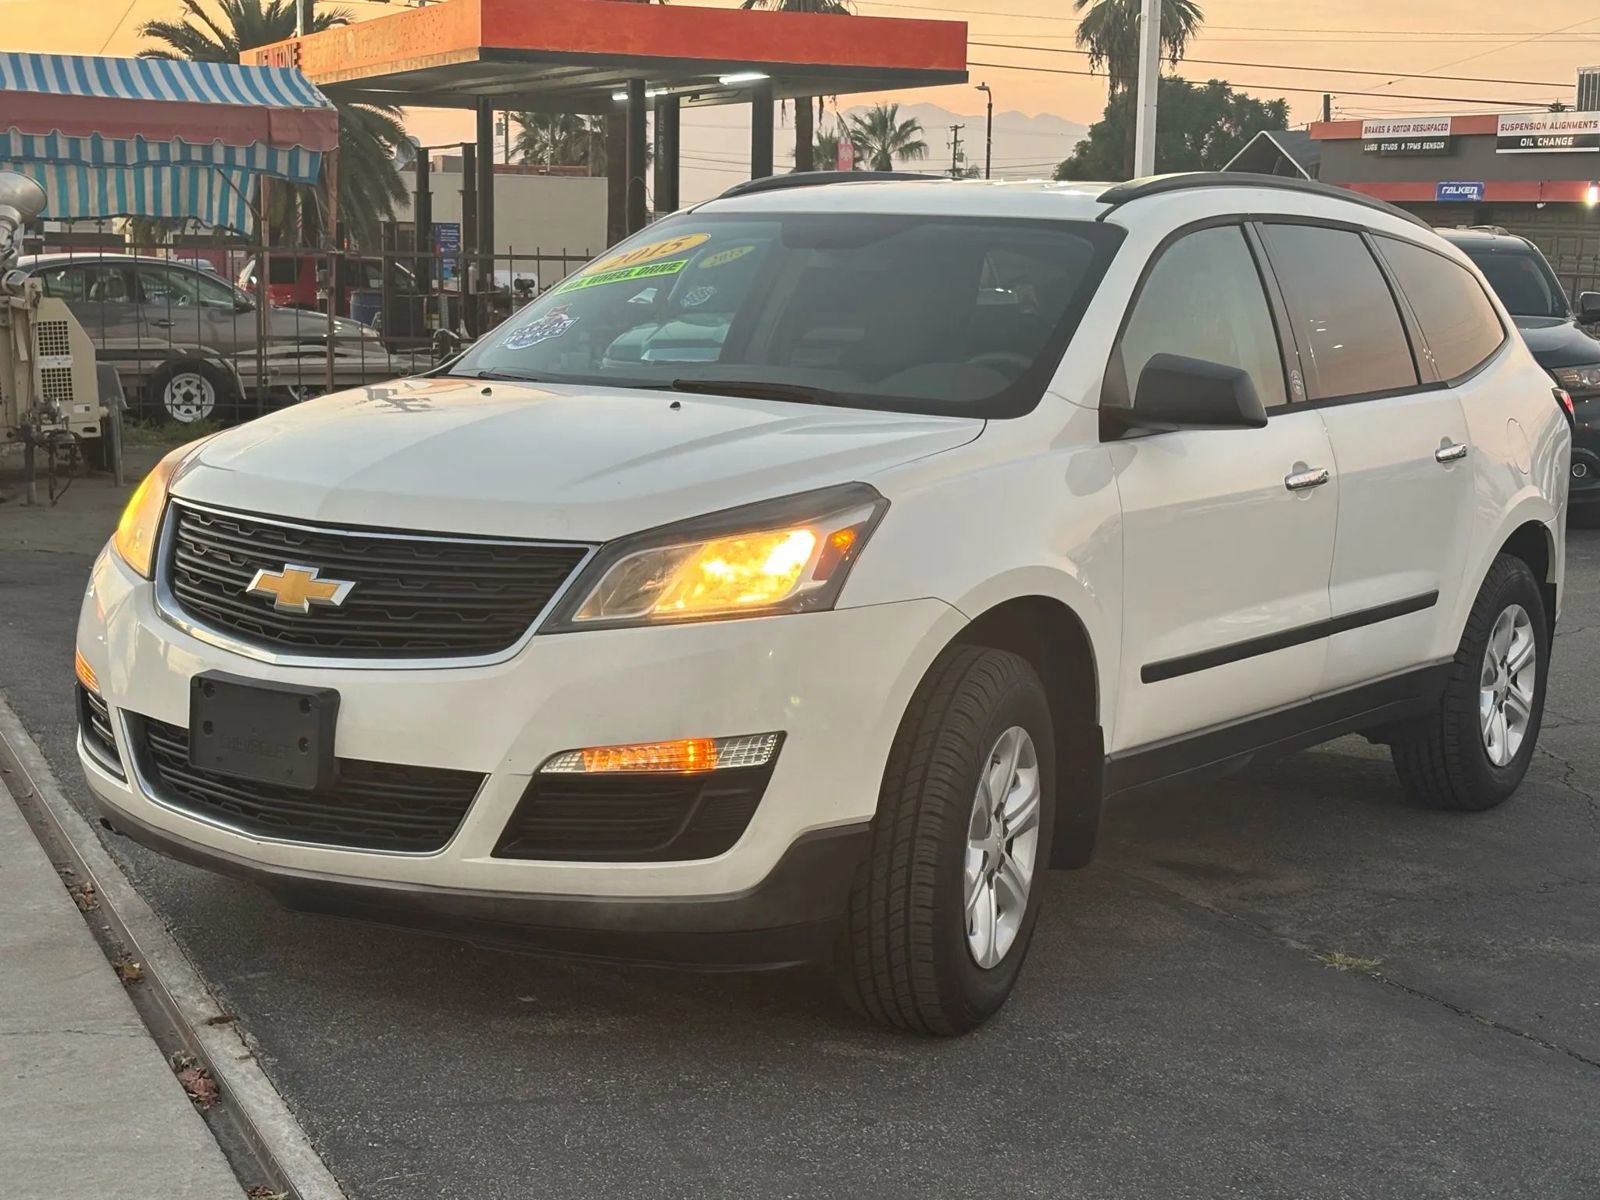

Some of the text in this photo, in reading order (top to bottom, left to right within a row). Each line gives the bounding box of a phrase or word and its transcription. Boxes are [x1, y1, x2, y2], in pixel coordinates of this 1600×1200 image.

[1364, 125, 1385, 134] BRAKES
[1392, 124, 1411, 133] ROTOR
[1412, 123, 1449, 133] RESURFACED
[1500, 120, 1599, 131] SUSPENSION ALIGNMENTS
[1380, 143, 1398, 151] STUDS
[1422, 141, 1445, 150] SENSOR
[1520, 136, 1574, 147] OIL CHANGE
[1441, 186, 1478, 195] FALKEN
[601, 236, 692, 270] 2015
[586, 268, 634, 285] WHEEL
[639, 260, 685, 276] DRIVE
